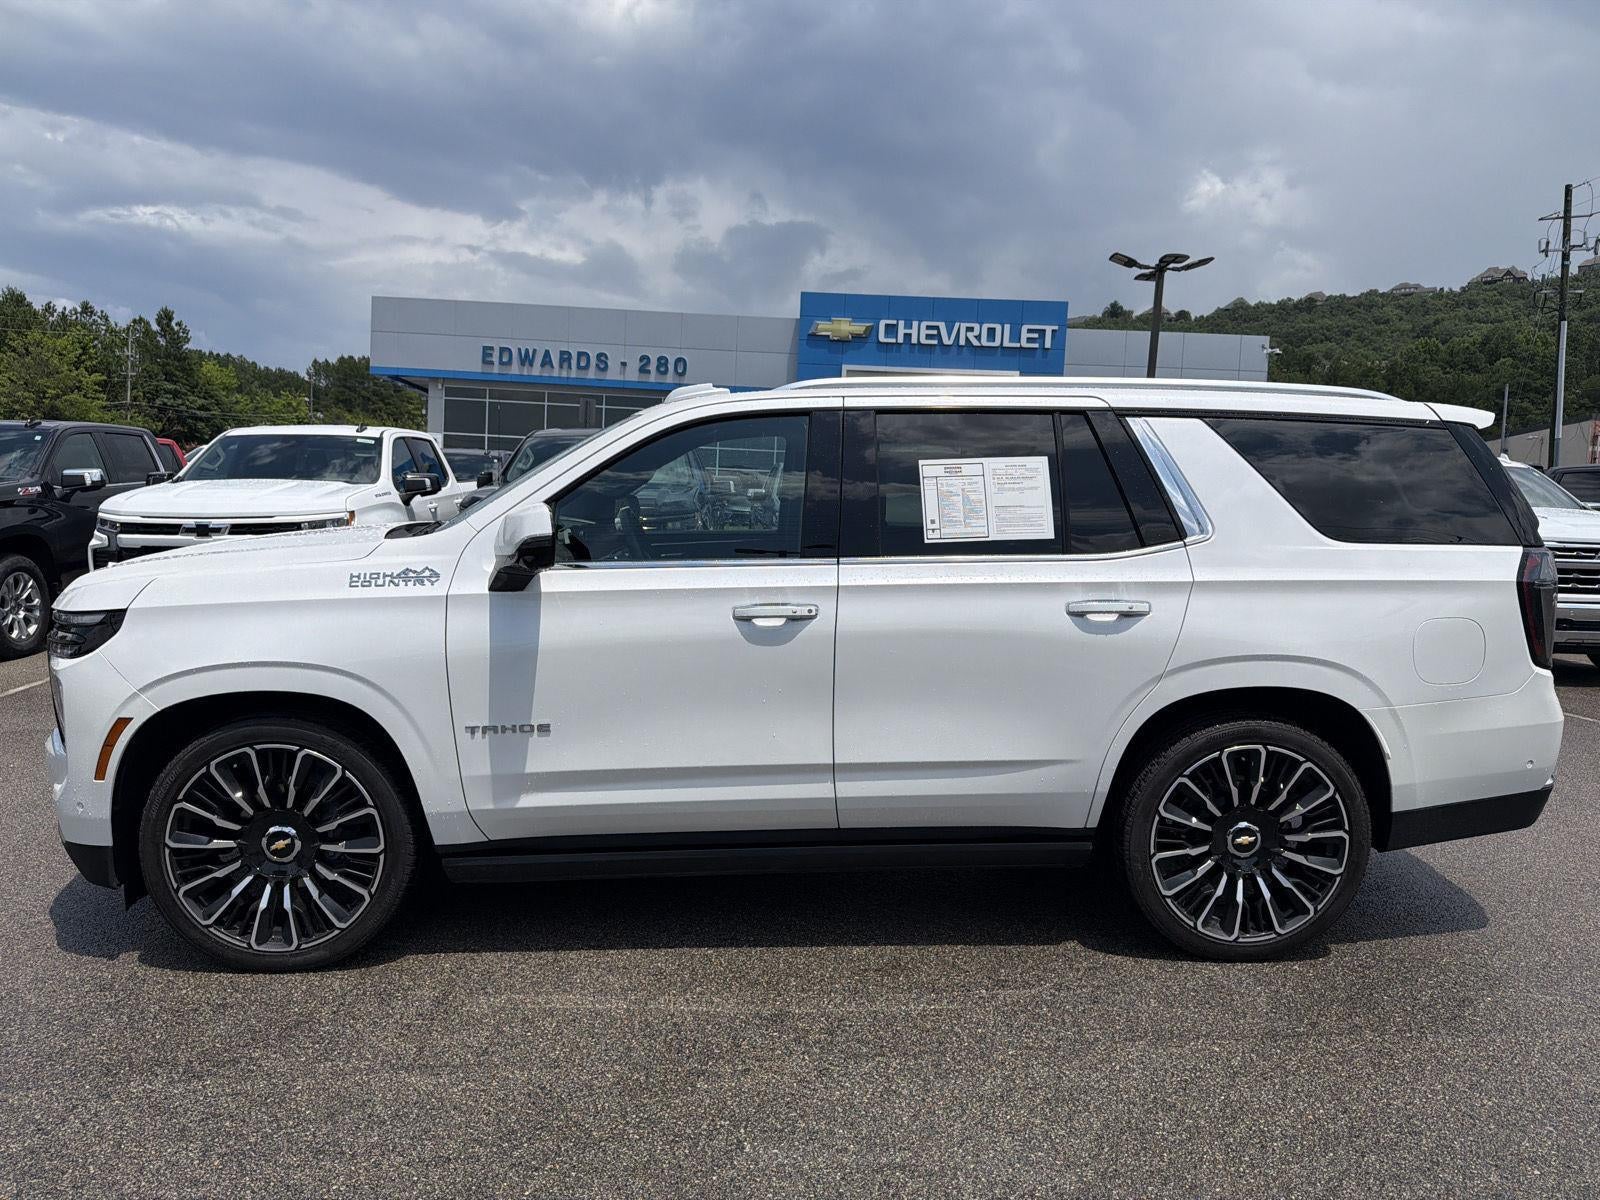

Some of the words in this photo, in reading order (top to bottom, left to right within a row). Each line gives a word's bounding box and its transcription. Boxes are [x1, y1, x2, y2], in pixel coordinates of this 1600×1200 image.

[878, 319, 1059, 349] CHEVROLET
[481, 345, 609, 372] EDWARDS
[638, 354, 688, 376] 280
[349, 572, 395, 580] HIGH
[349, 578, 440, 587] COUNTRY
[465, 724, 552, 736] TAHOE
